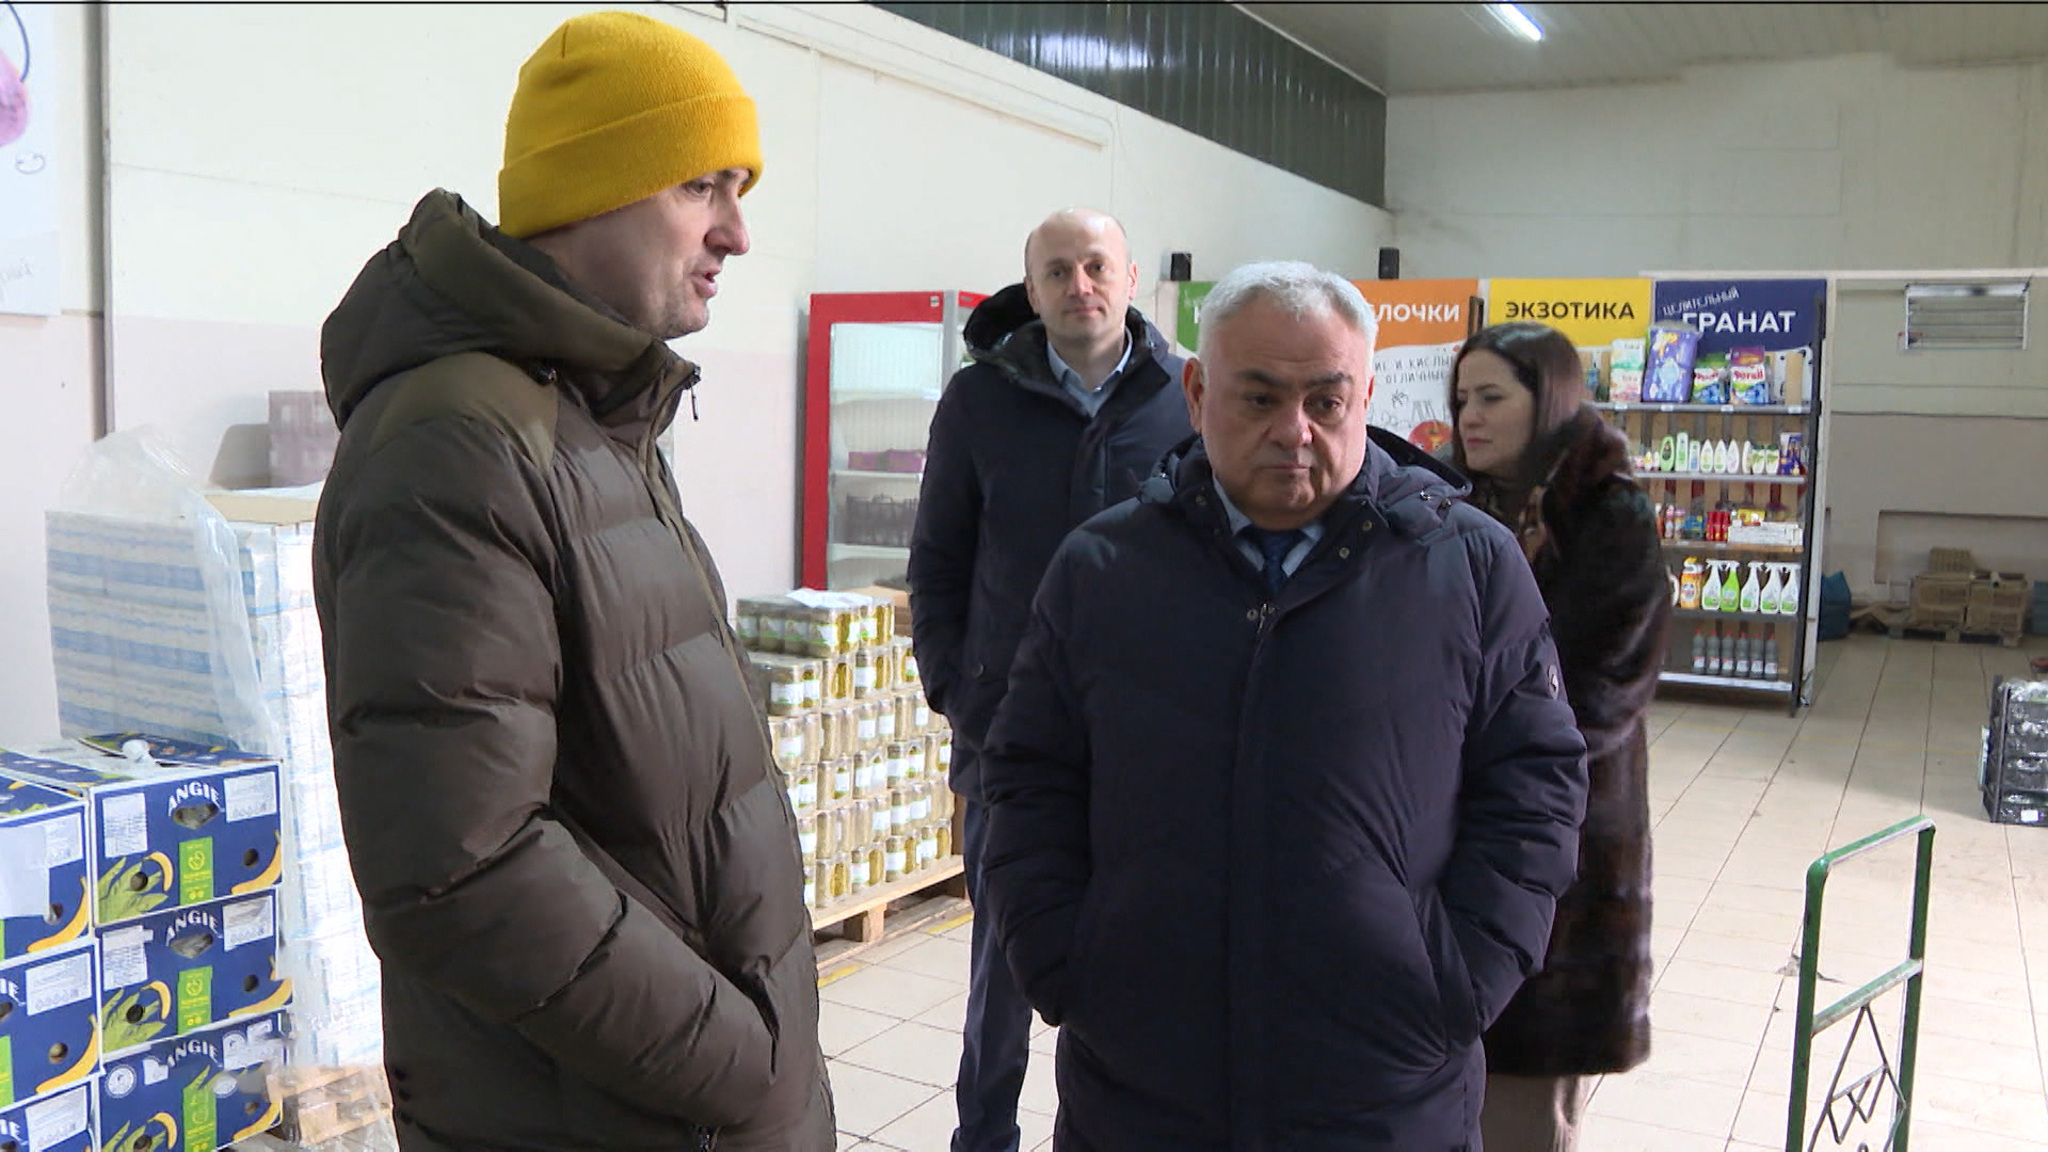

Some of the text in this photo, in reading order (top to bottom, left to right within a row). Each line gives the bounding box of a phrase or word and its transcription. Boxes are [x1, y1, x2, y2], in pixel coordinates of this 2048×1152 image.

[1374, 303, 1460, 322] ЛОЧКИ
[1505, 301, 1635, 320] ЭКЗОТИКА
[1682, 310, 1797, 333] ГРАНАТ
[167, 780, 226, 817] ANGIE
[165, 909, 223, 947] ANGIE
